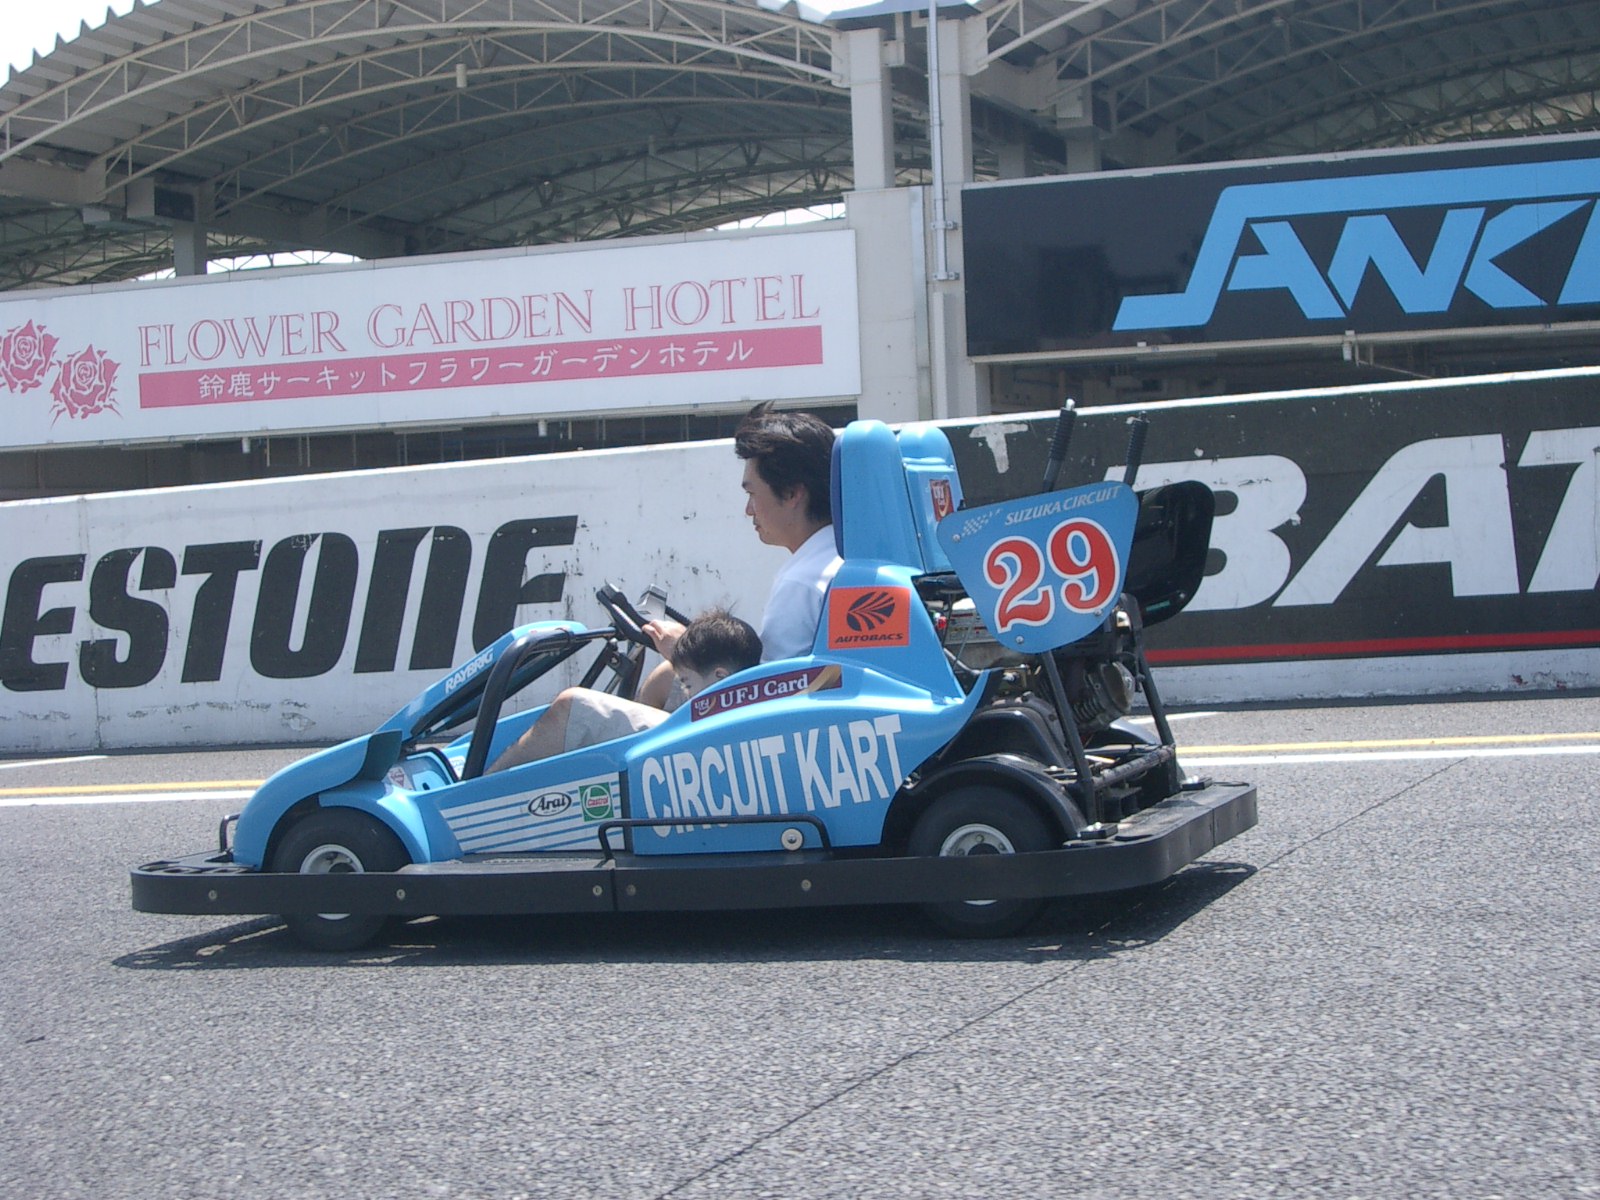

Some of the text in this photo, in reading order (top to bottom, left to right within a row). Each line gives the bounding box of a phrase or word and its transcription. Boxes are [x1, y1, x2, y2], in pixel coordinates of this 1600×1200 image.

[138, 274, 820, 367] FLOWER GARDEN HOTEL
[198, 339, 754, 400] 鈴鹿サーキットフラワーガーデンホテル
[1004, 486, 1123, 525] SUZUKA CIRCUIT
[983, 517, 1120, 634] 29
[835, 633, 904, 643] AUTOBACS
[445, 647, 494, 694] RAYBRIG
[720, 673, 809, 708] UFJ Card
[641, 714, 902, 838] CIRCUIT KART
[534, 794, 566, 811] Arai
